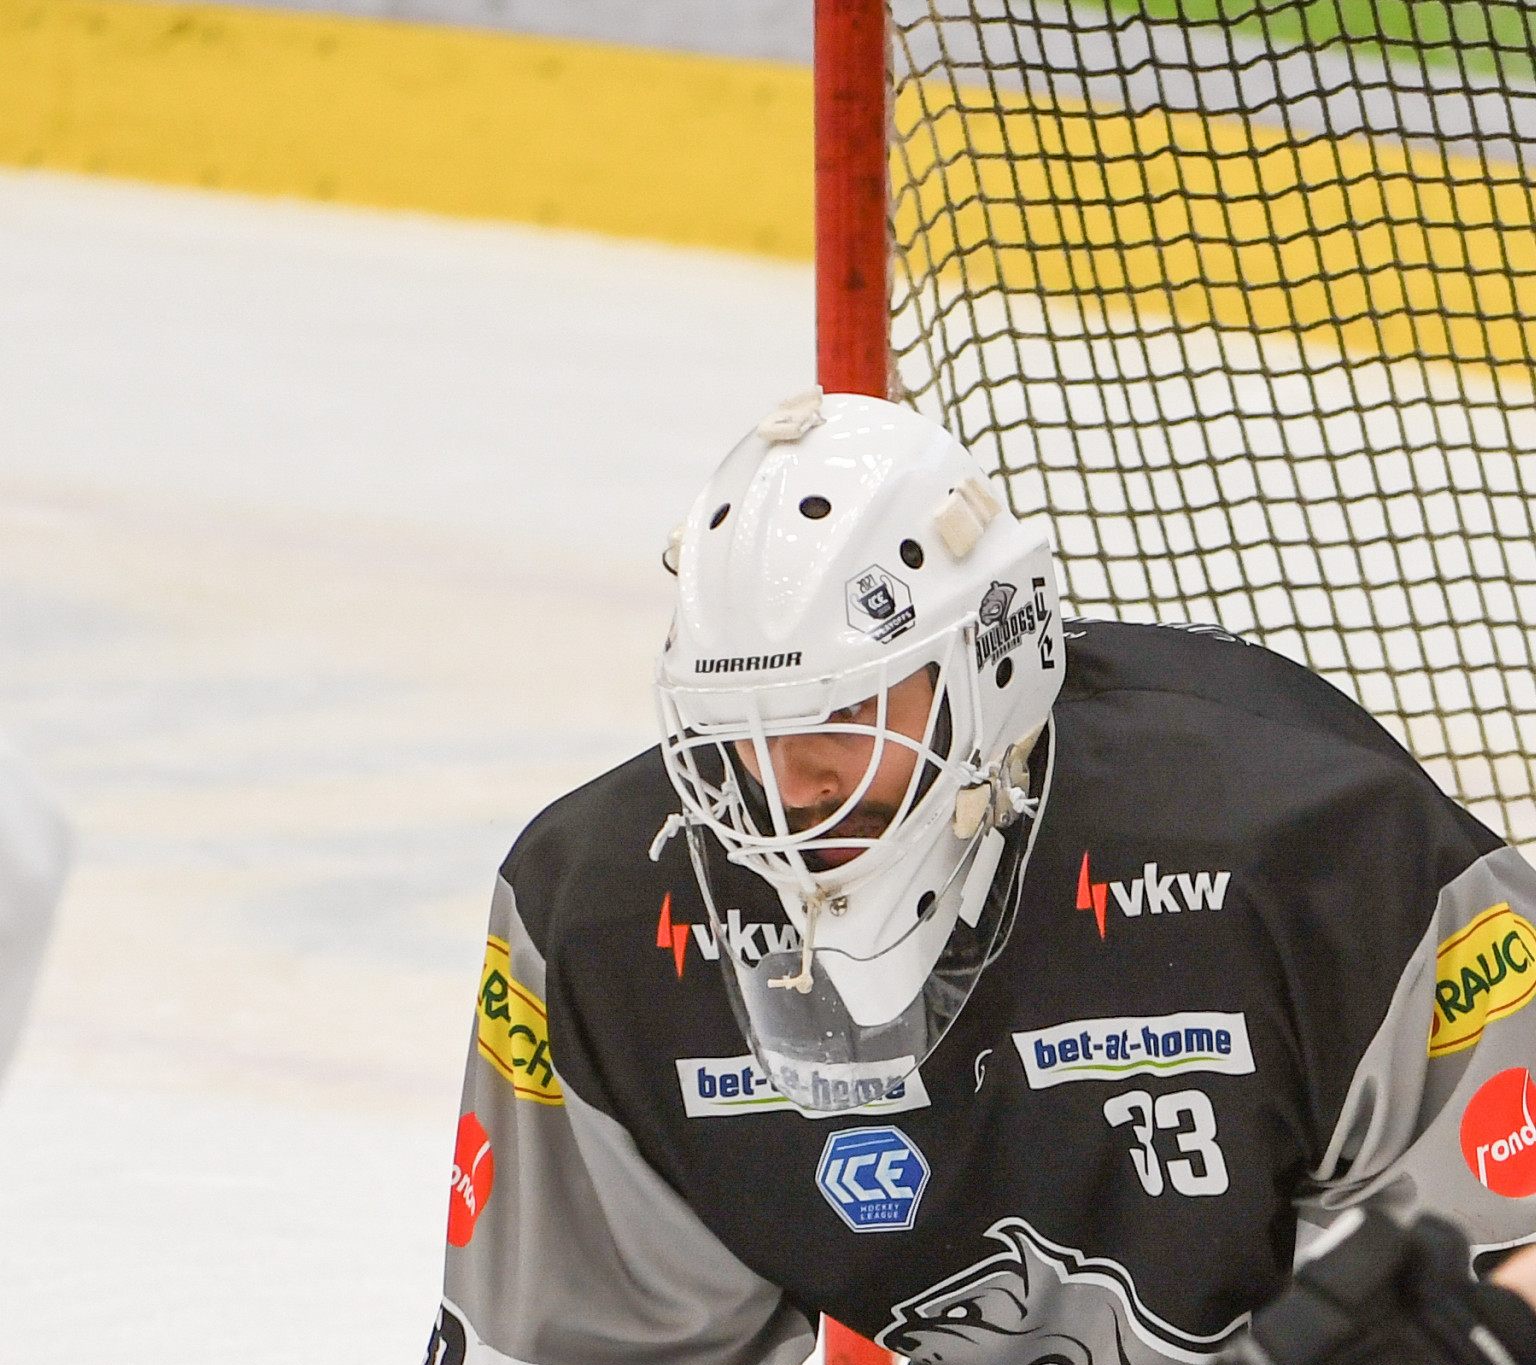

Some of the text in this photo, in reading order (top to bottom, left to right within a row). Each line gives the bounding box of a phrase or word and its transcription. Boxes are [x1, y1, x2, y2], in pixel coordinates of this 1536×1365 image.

[695, 651, 802, 674] WARRIOR
[1109, 862, 1231, 918] vkw
[1436, 930, 1536, 1023] RAUC
[1034, 1025, 1232, 1070] bet-at-home
[1103, 1089, 1229, 1197] 33
[824, 1149, 918, 1204] ICE
[860, 1203, 900, 1212] HOCKEY
[860, 1211, 899, 1220] LEAGUE
